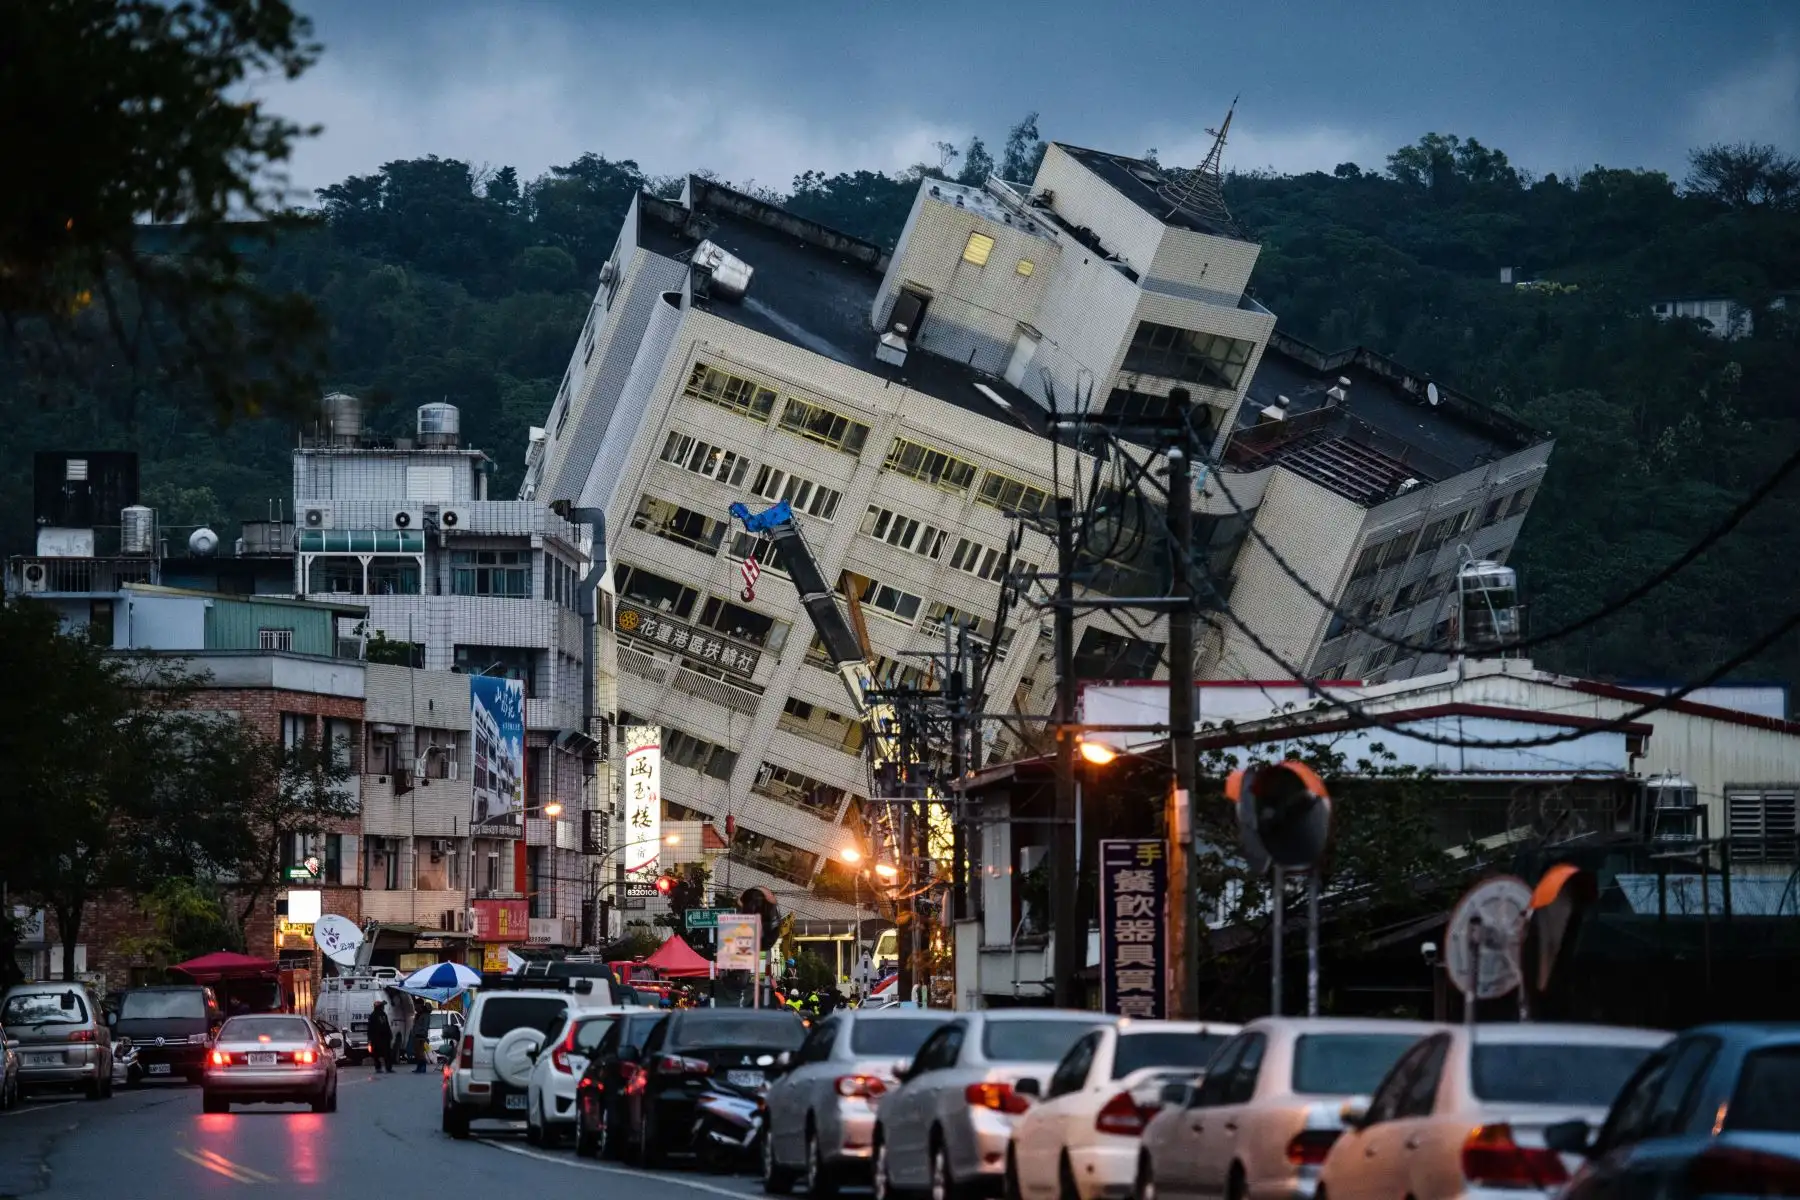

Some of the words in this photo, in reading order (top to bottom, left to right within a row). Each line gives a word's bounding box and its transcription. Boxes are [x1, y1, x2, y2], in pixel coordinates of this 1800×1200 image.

[640, 616, 753, 673] 花蓮港區扶輪社
[1106, 844, 1162, 866] 二手
[1114, 869, 1156, 1018] 餐飲器具買賣
